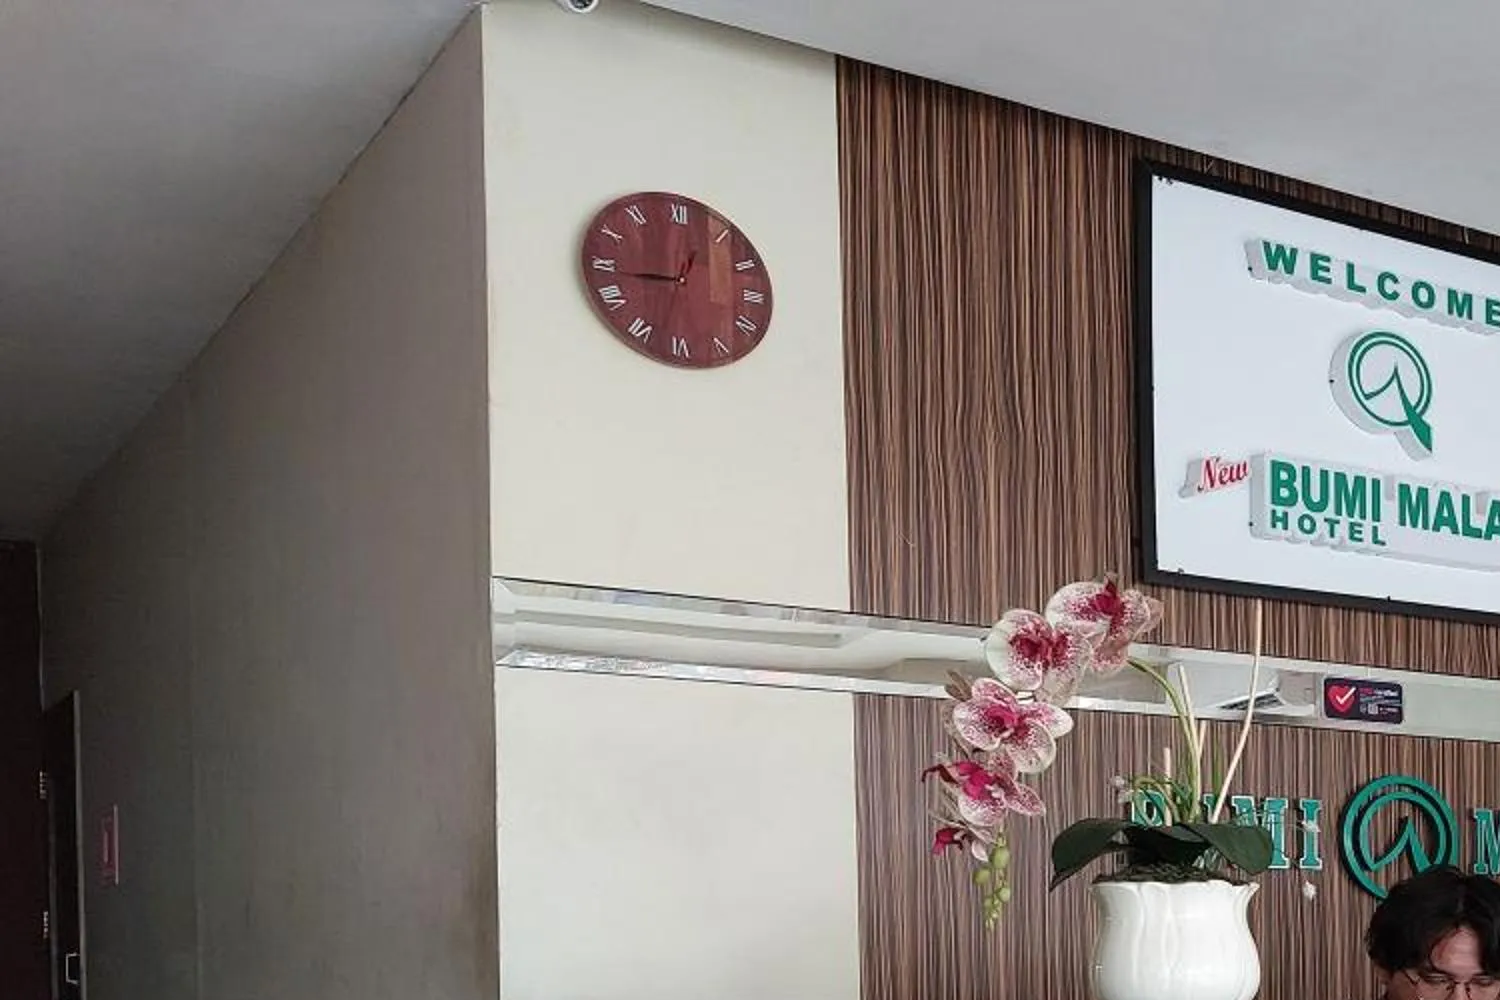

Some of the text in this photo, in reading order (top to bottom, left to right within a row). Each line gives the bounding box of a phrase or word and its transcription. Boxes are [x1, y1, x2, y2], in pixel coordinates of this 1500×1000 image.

[671, 203, 688, 225] XII
[735, 259, 755, 271] II
[743, 289, 764, 305] III
[1198, 456, 1248, 492] New
[1270, 460, 1381, 523] BUMI
[1270, 510, 1386, 546] HOTEL
[1128, 788, 1322, 870] MI
